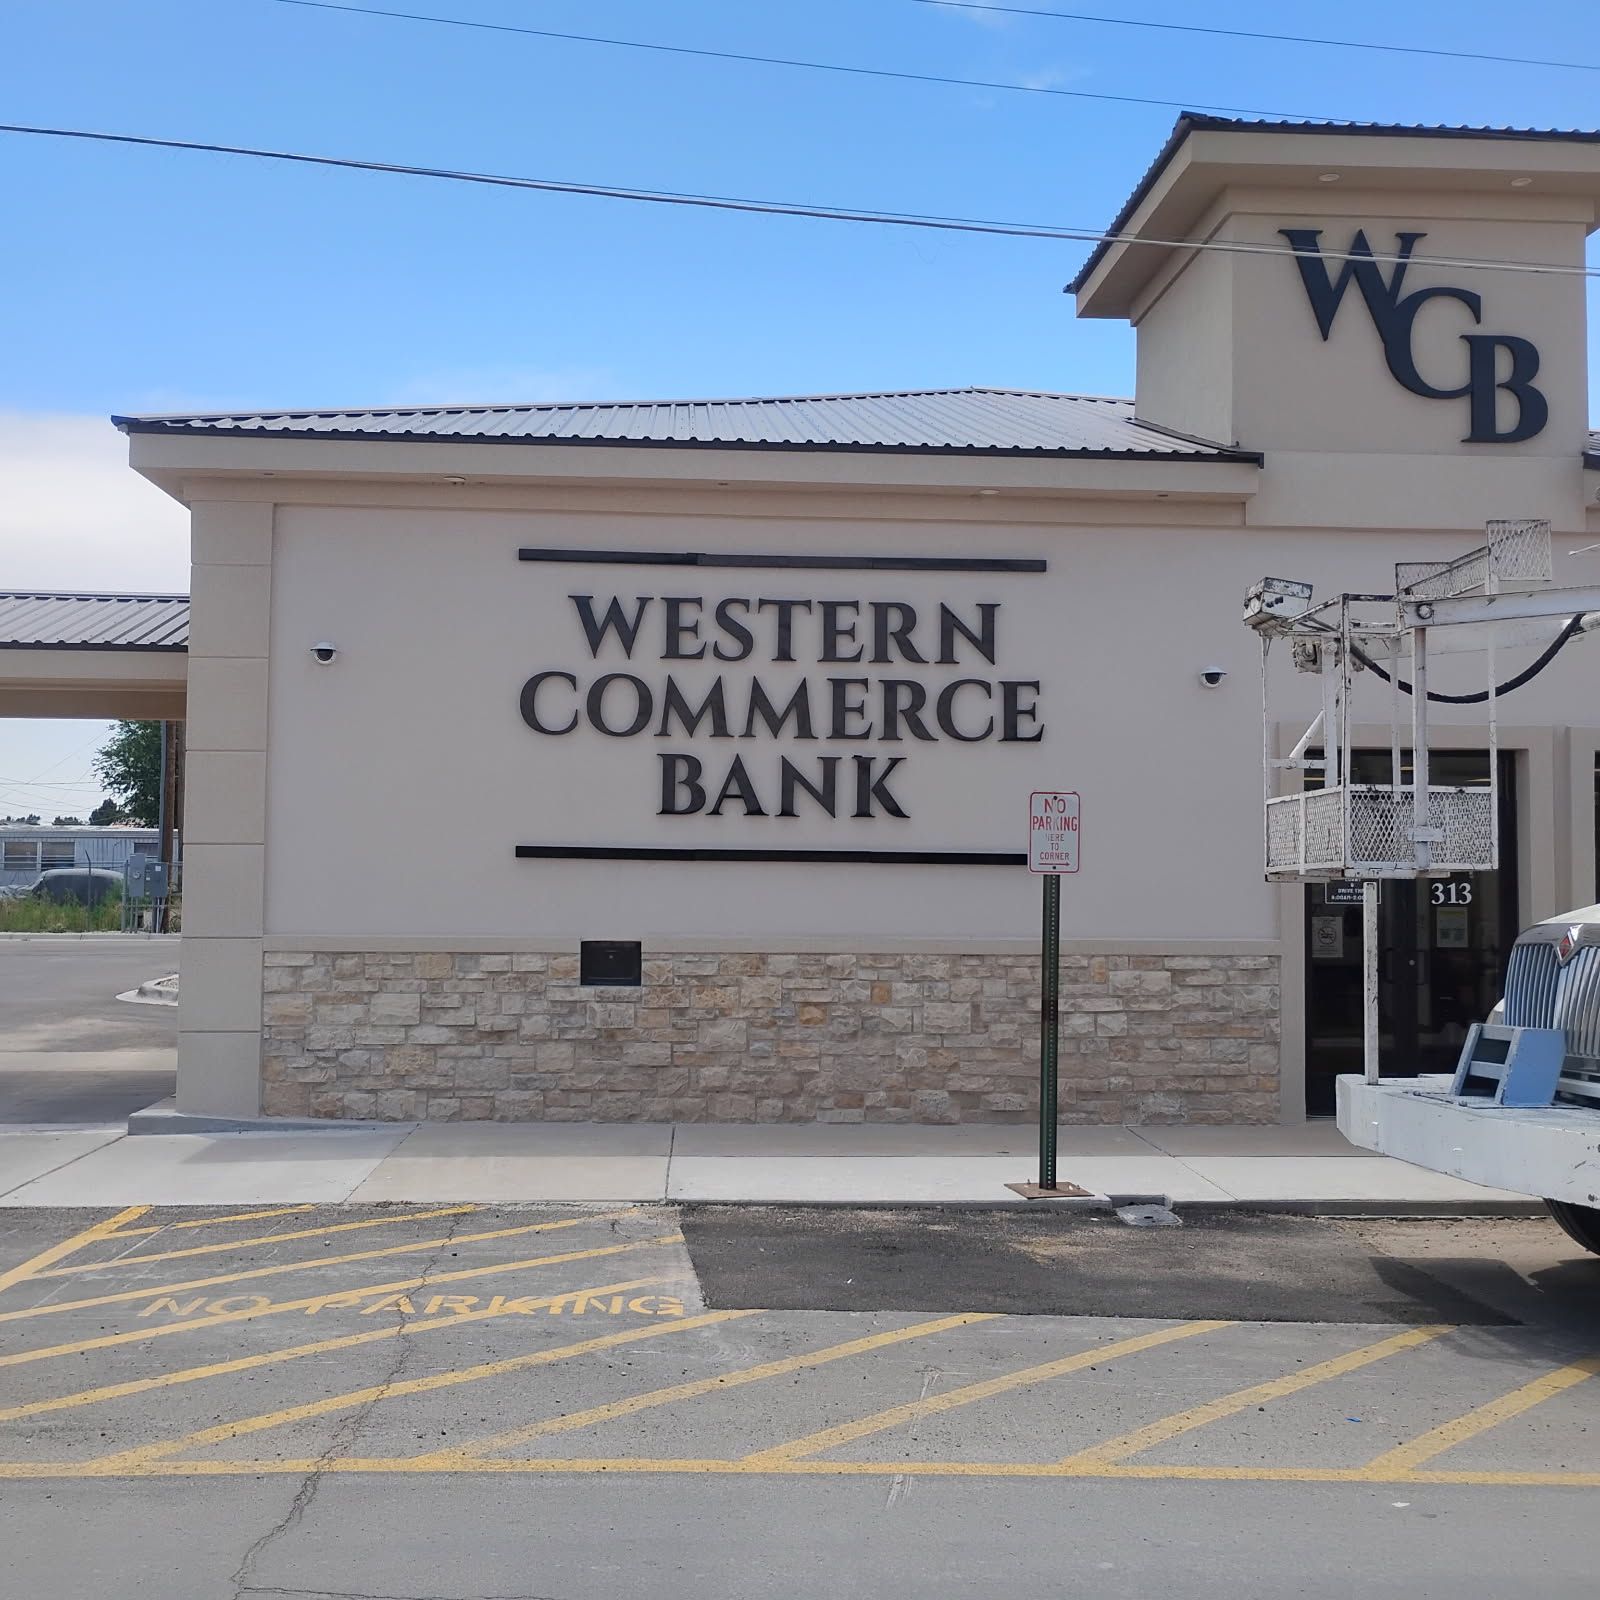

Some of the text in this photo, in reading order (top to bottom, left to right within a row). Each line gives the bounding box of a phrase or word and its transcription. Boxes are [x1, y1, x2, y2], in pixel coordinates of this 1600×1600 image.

[1277, 228, 1549, 444] WCB
[568, 595, 1002, 665] WESTERN
[519, 671, 1045, 742] COMMERCE
[656, 753, 910, 819] BANK
[1044, 798, 1066, 813] NO
[1032, 816, 1078, 831] PARKING
[1039, 852, 1070, 861] CORNER
[1050, 842, 1060, 851] TO
[1431, 882, 1473, 905] 313
[137, 1295, 686, 1317] NO PARKING
